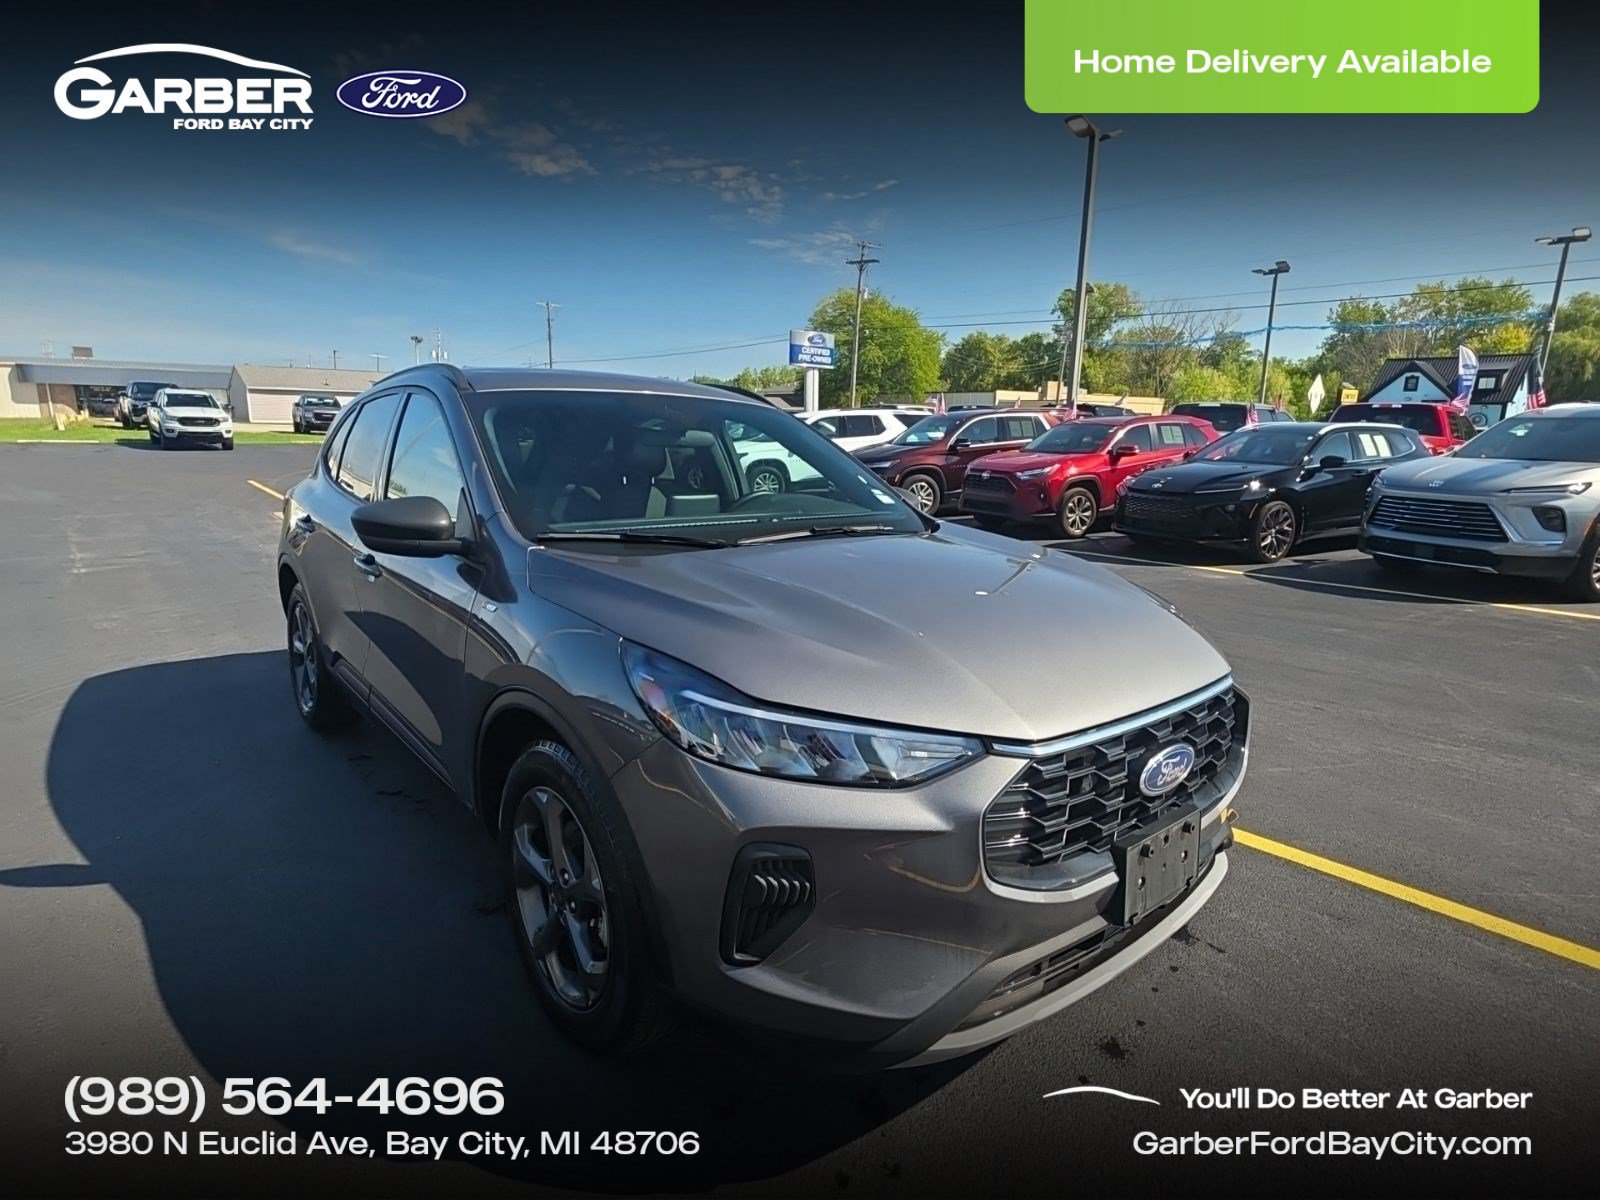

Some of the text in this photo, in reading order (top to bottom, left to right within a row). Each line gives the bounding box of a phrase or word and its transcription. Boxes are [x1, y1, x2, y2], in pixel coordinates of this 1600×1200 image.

[801, 346, 831, 356] CERTIFIED
[798, 354, 832, 364] PRE-OWNED
[1156, 755, 1188, 787] Ford
